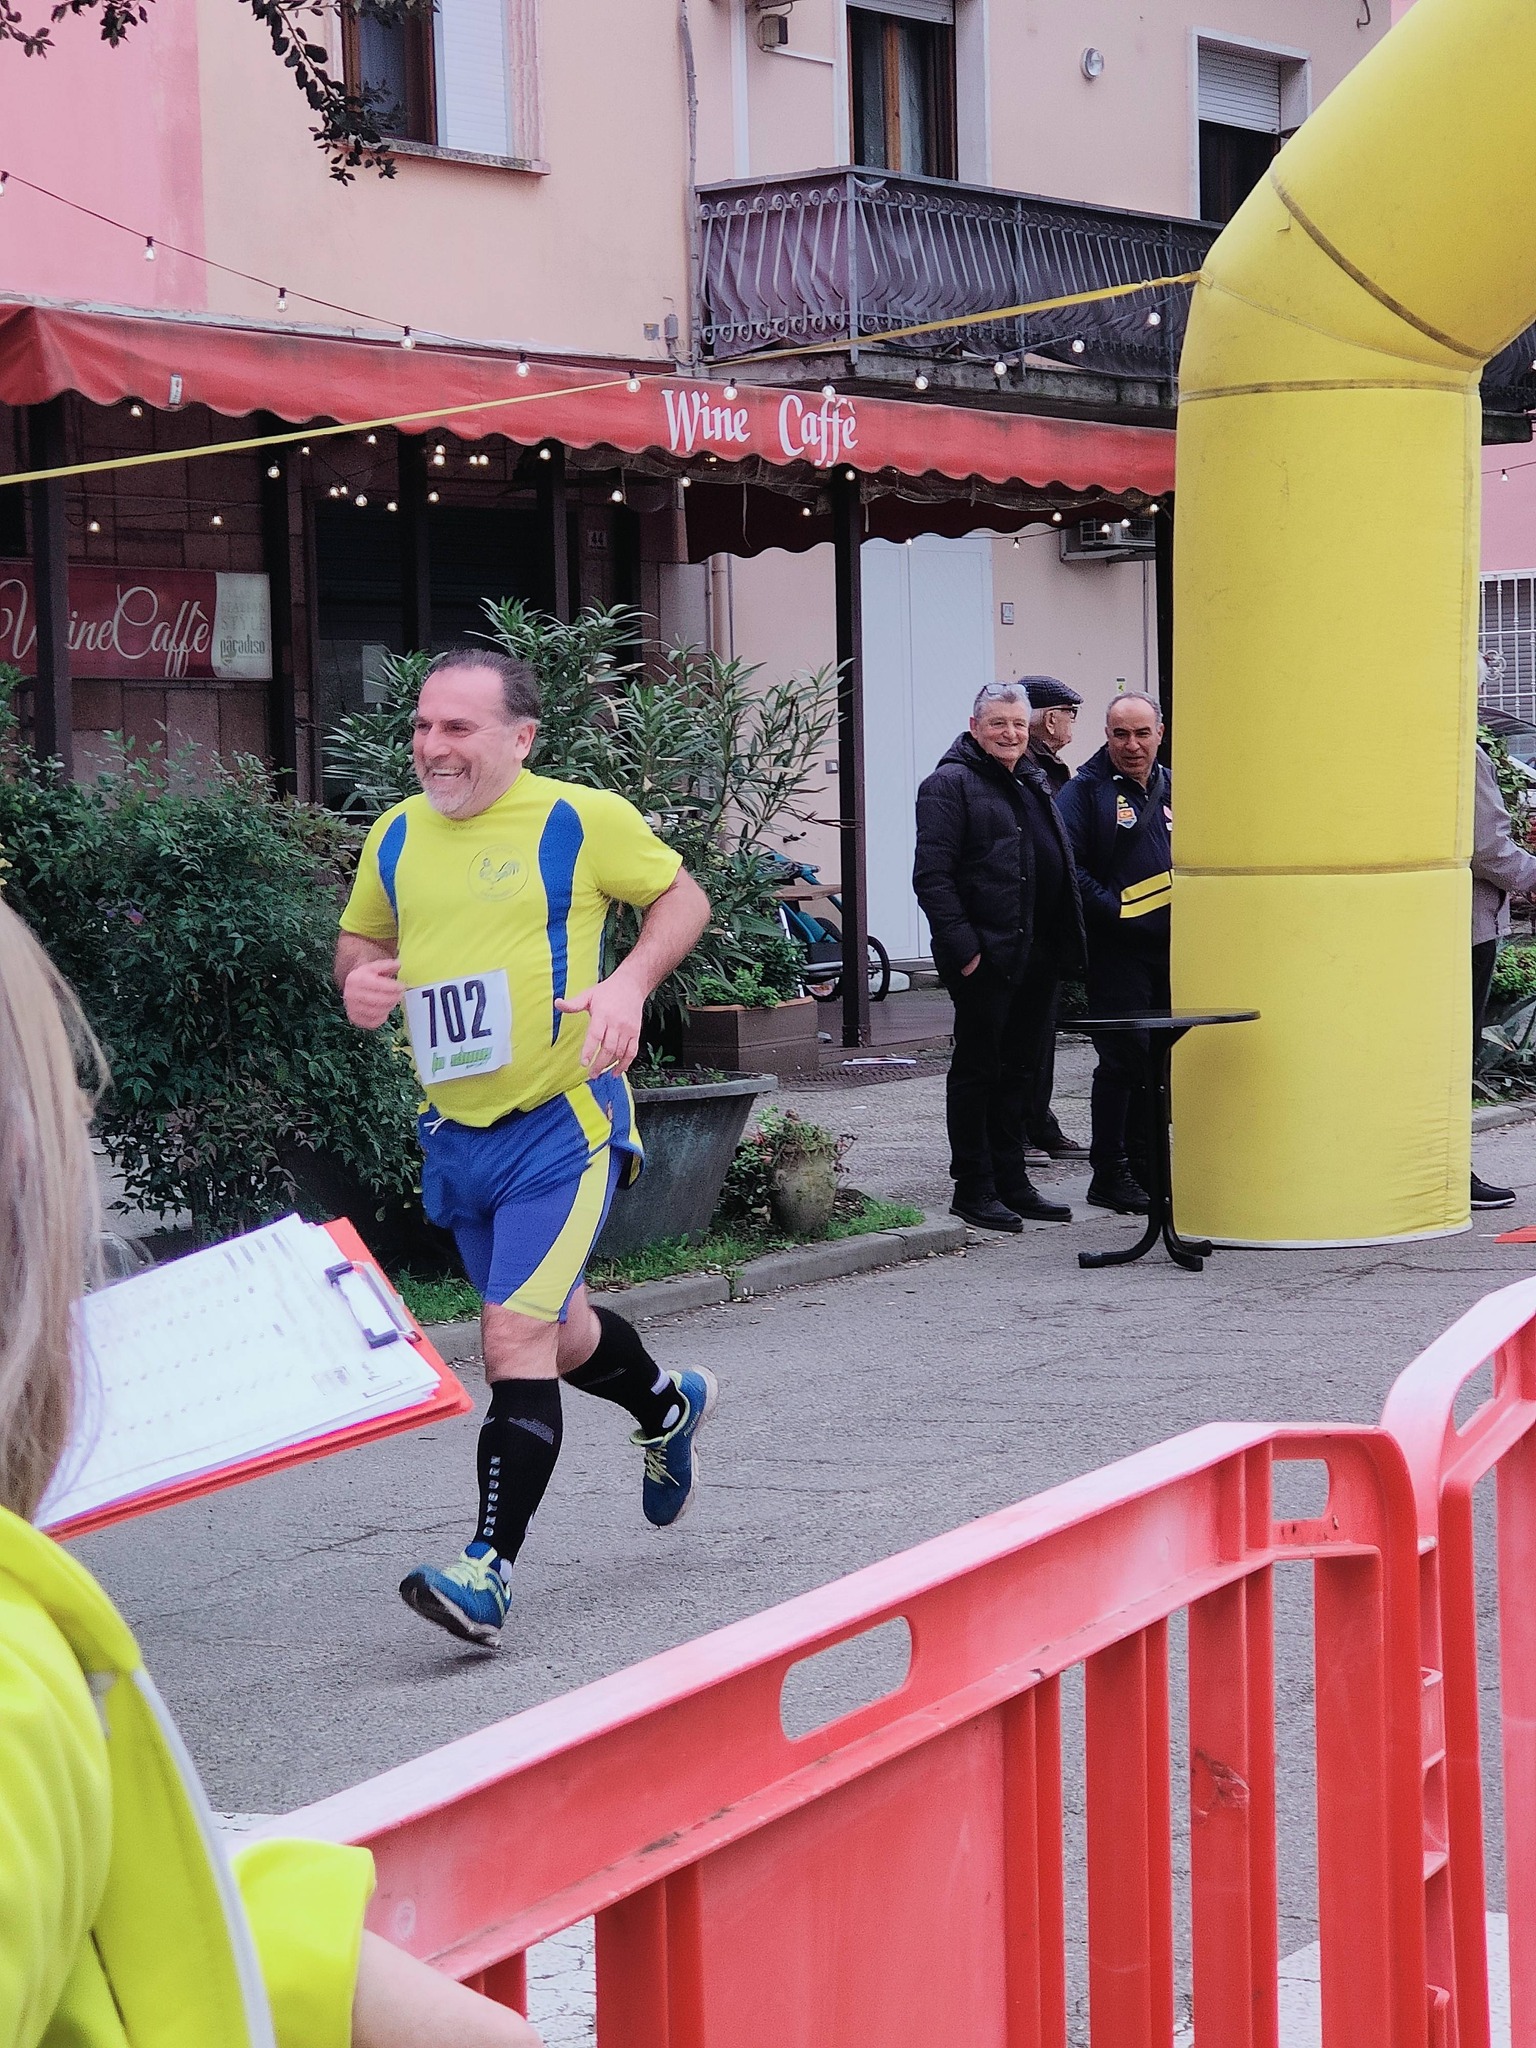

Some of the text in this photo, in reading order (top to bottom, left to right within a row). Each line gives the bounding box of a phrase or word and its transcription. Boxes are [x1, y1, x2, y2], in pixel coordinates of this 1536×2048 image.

[661, 389, 858, 467] Wine Caffè
[421, 979, 492, 1048] 702
